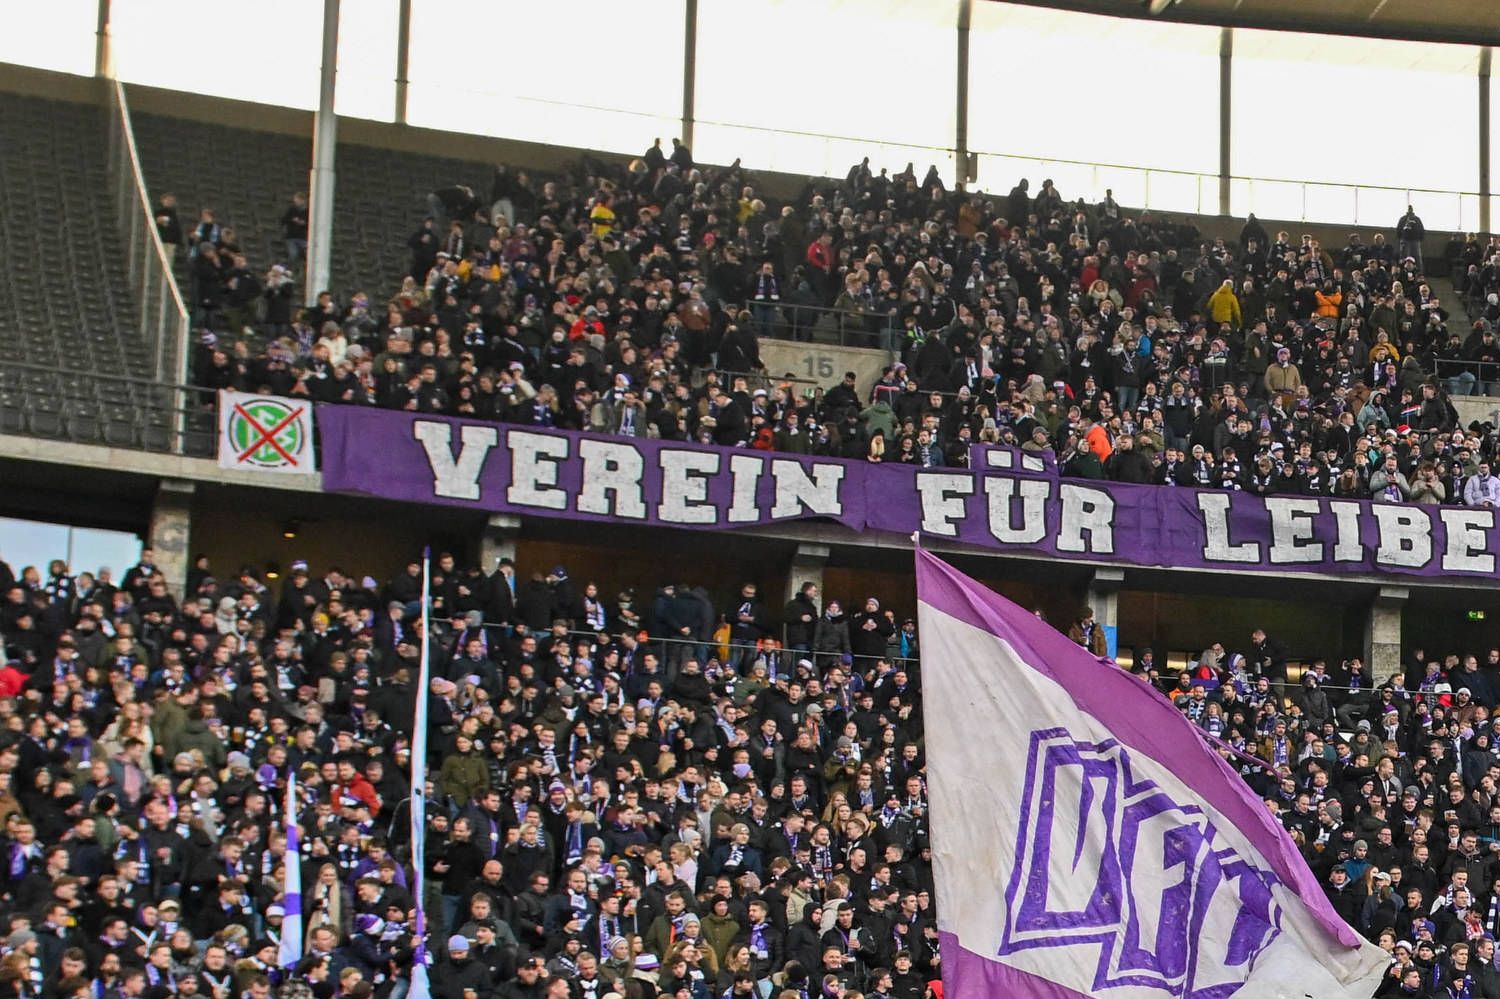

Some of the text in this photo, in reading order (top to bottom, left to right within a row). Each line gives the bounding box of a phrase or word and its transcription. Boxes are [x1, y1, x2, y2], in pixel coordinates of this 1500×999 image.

[803, 356, 833, 378] 15
[413, 419, 846, 524] VEREIN
[915, 448, 1116, 553] FÜR
